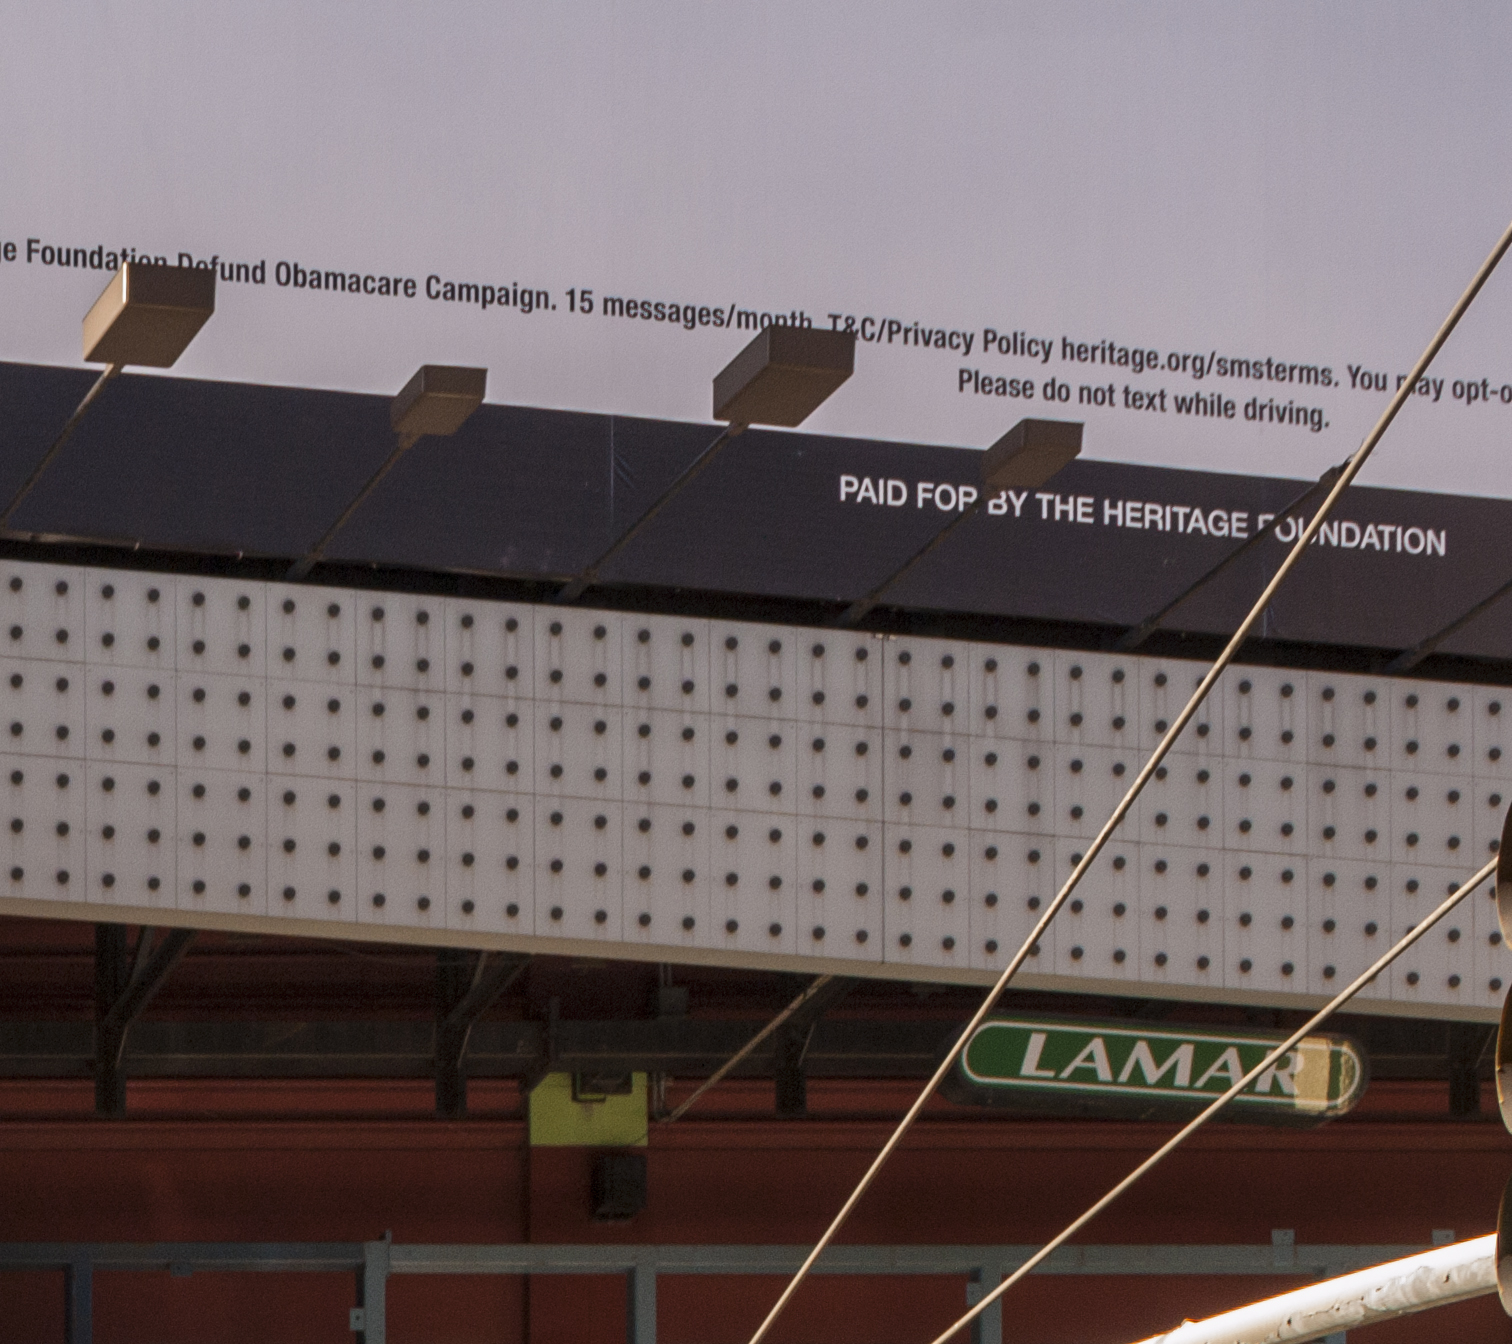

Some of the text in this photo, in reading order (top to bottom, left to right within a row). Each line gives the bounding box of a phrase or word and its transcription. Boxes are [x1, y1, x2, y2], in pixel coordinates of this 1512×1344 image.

[273, 259, 418, 301] Obamacare
[424, 272, 558, 313] Campaign.
[564, 288, 596, 316] 15
[982, 327, 1054, 365] Policy
[1060, 335, 1341, 392] heritage.org/smsterms.
[1346, 363, 1390, 393] You
[957, 367, 1331, 431] Please do not text while driving.
[838, 474, 908, 508] PAID
[987, 489, 1027, 518] BY
[1035, 492, 1095, 524] THE
[1102, 498, 1250, 540] HERITAGE
[1018, 1028, 1305, 1101] LAMAR
